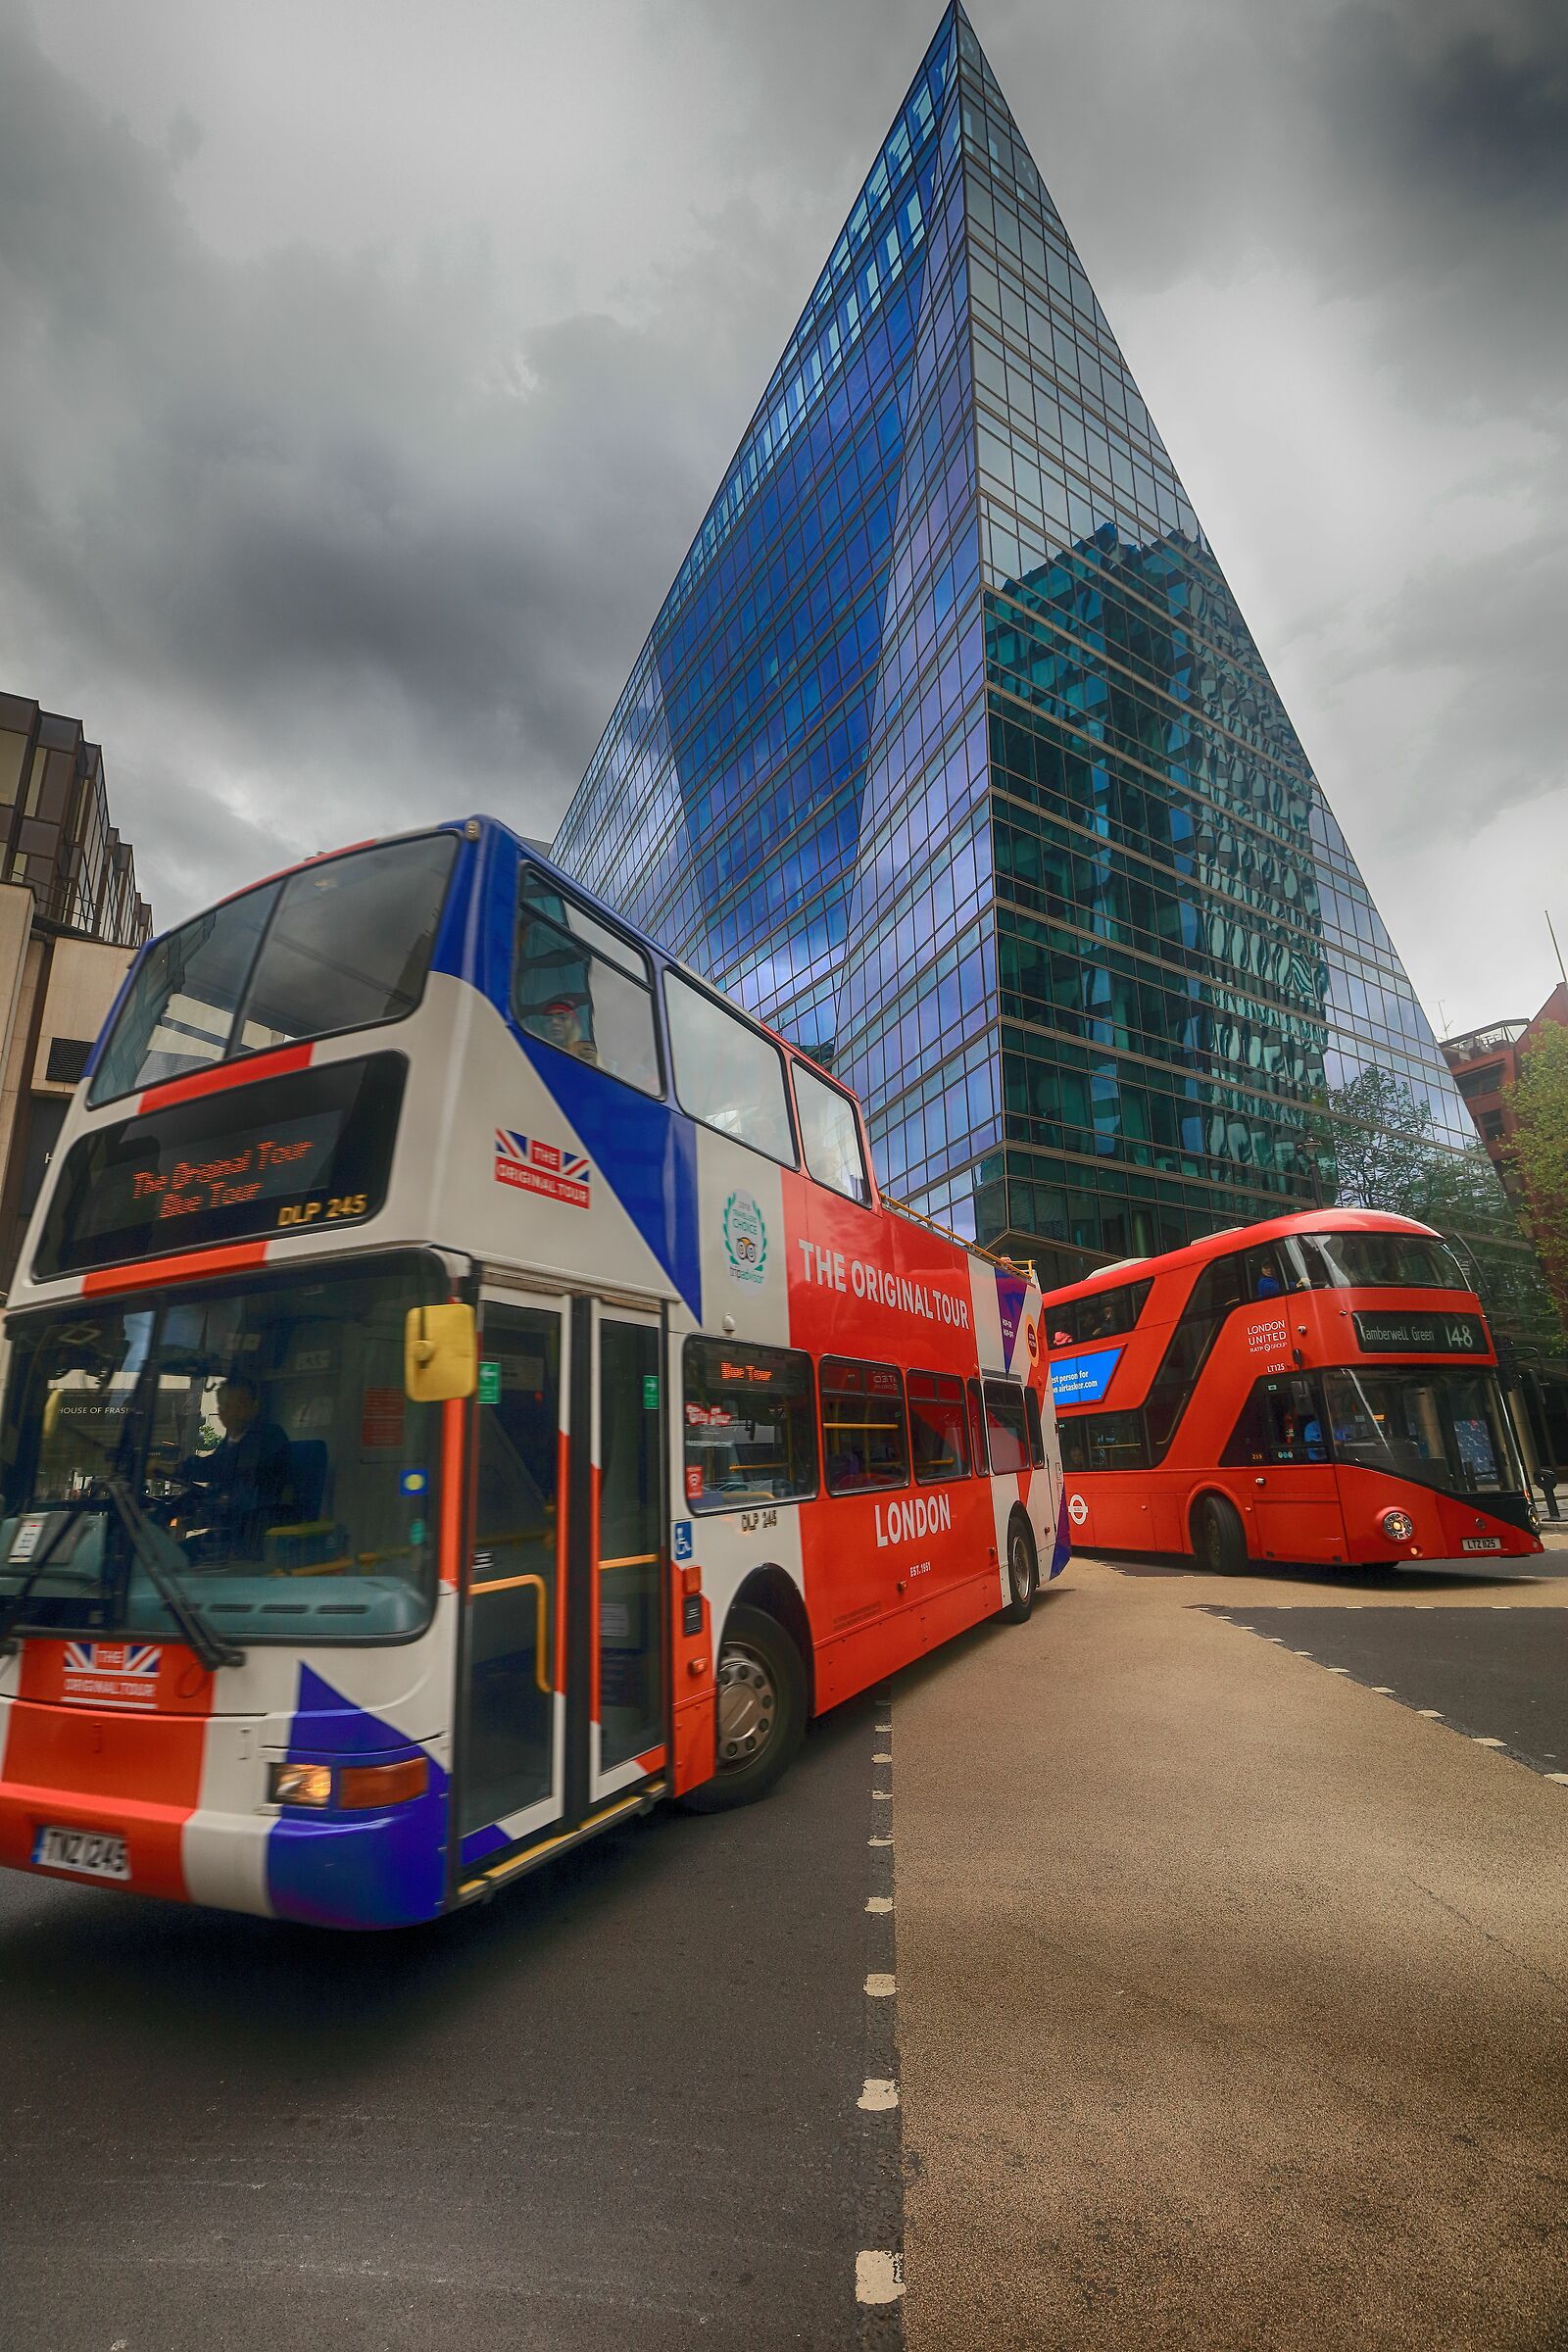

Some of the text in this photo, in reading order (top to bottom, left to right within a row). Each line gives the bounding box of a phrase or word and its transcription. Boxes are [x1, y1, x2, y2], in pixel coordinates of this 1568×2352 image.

[532, 1146, 560, 1166] THE
[132, 1171, 169, 1200] The
[257, 1140, 315, 1171] Tour
[497, 1163, 589, 1204] ORIGINAL TOUR
[209, 1181, 263, 1207] Tour
[278, 1194, 368, 1226] DLP 245
[799, 1239, 969, 1330] THE ORIGINAL TOUR
[1247, 1319, 1286, 1336] LONDON
[1411, 1326, 1435, 1342] Green
[1446, 1325, 1473, 1348] 148
[1248, 1331, 1287, 1346] UNITED
[1270, 1342, 1288, 1350] GROUP
[1058, 1372, 1079, 1385] person
[1079, 1370, 1089, 1379] for
[1266, 1362, 1285, 1373] LT125
[741, 1512, 759, 1532] DLP
[874, 1494, 952, 1548] LONDON
[97, 1649, 124, 1664] THE
[63, 1677, 158, 1697] ORIGINAL TOUR
